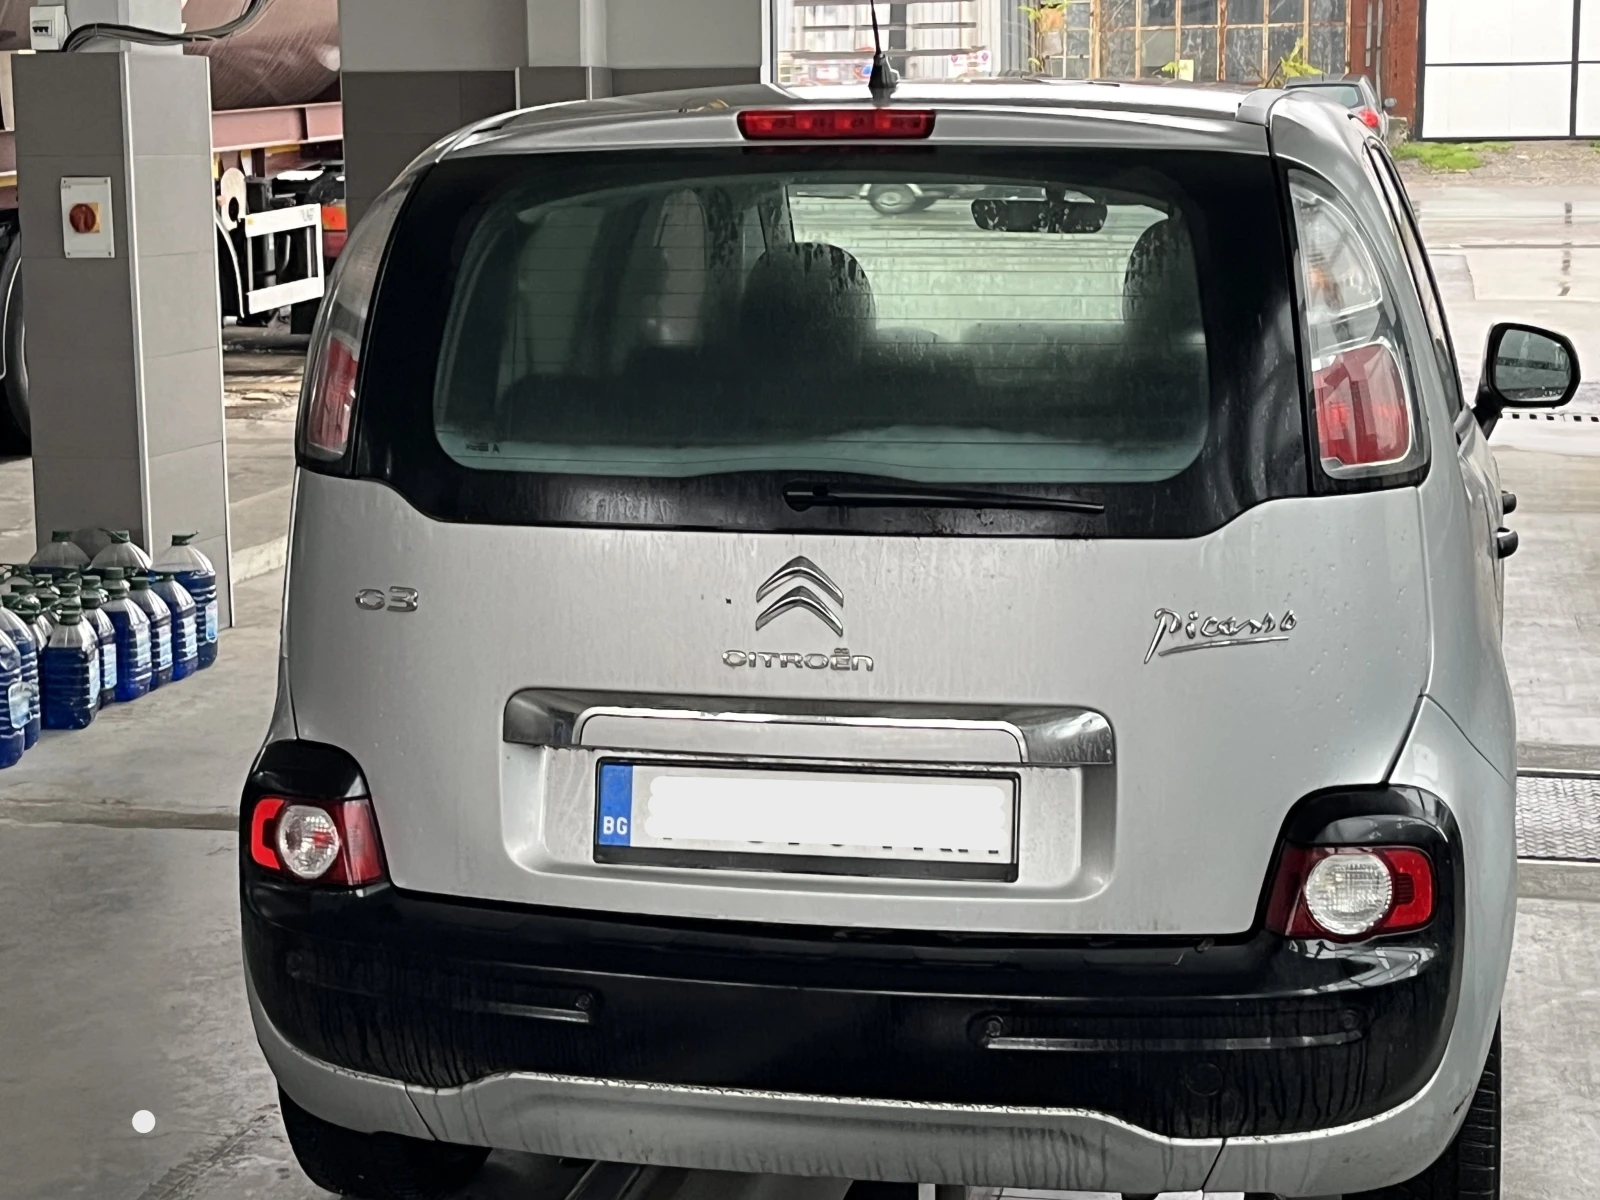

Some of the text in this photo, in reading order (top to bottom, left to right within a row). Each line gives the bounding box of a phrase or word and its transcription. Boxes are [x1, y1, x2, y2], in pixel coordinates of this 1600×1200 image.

[355, 585, 419, 612] C3
[1143, 607, 1297, 664] Picasso
[603, 815, 628, 835] BG
